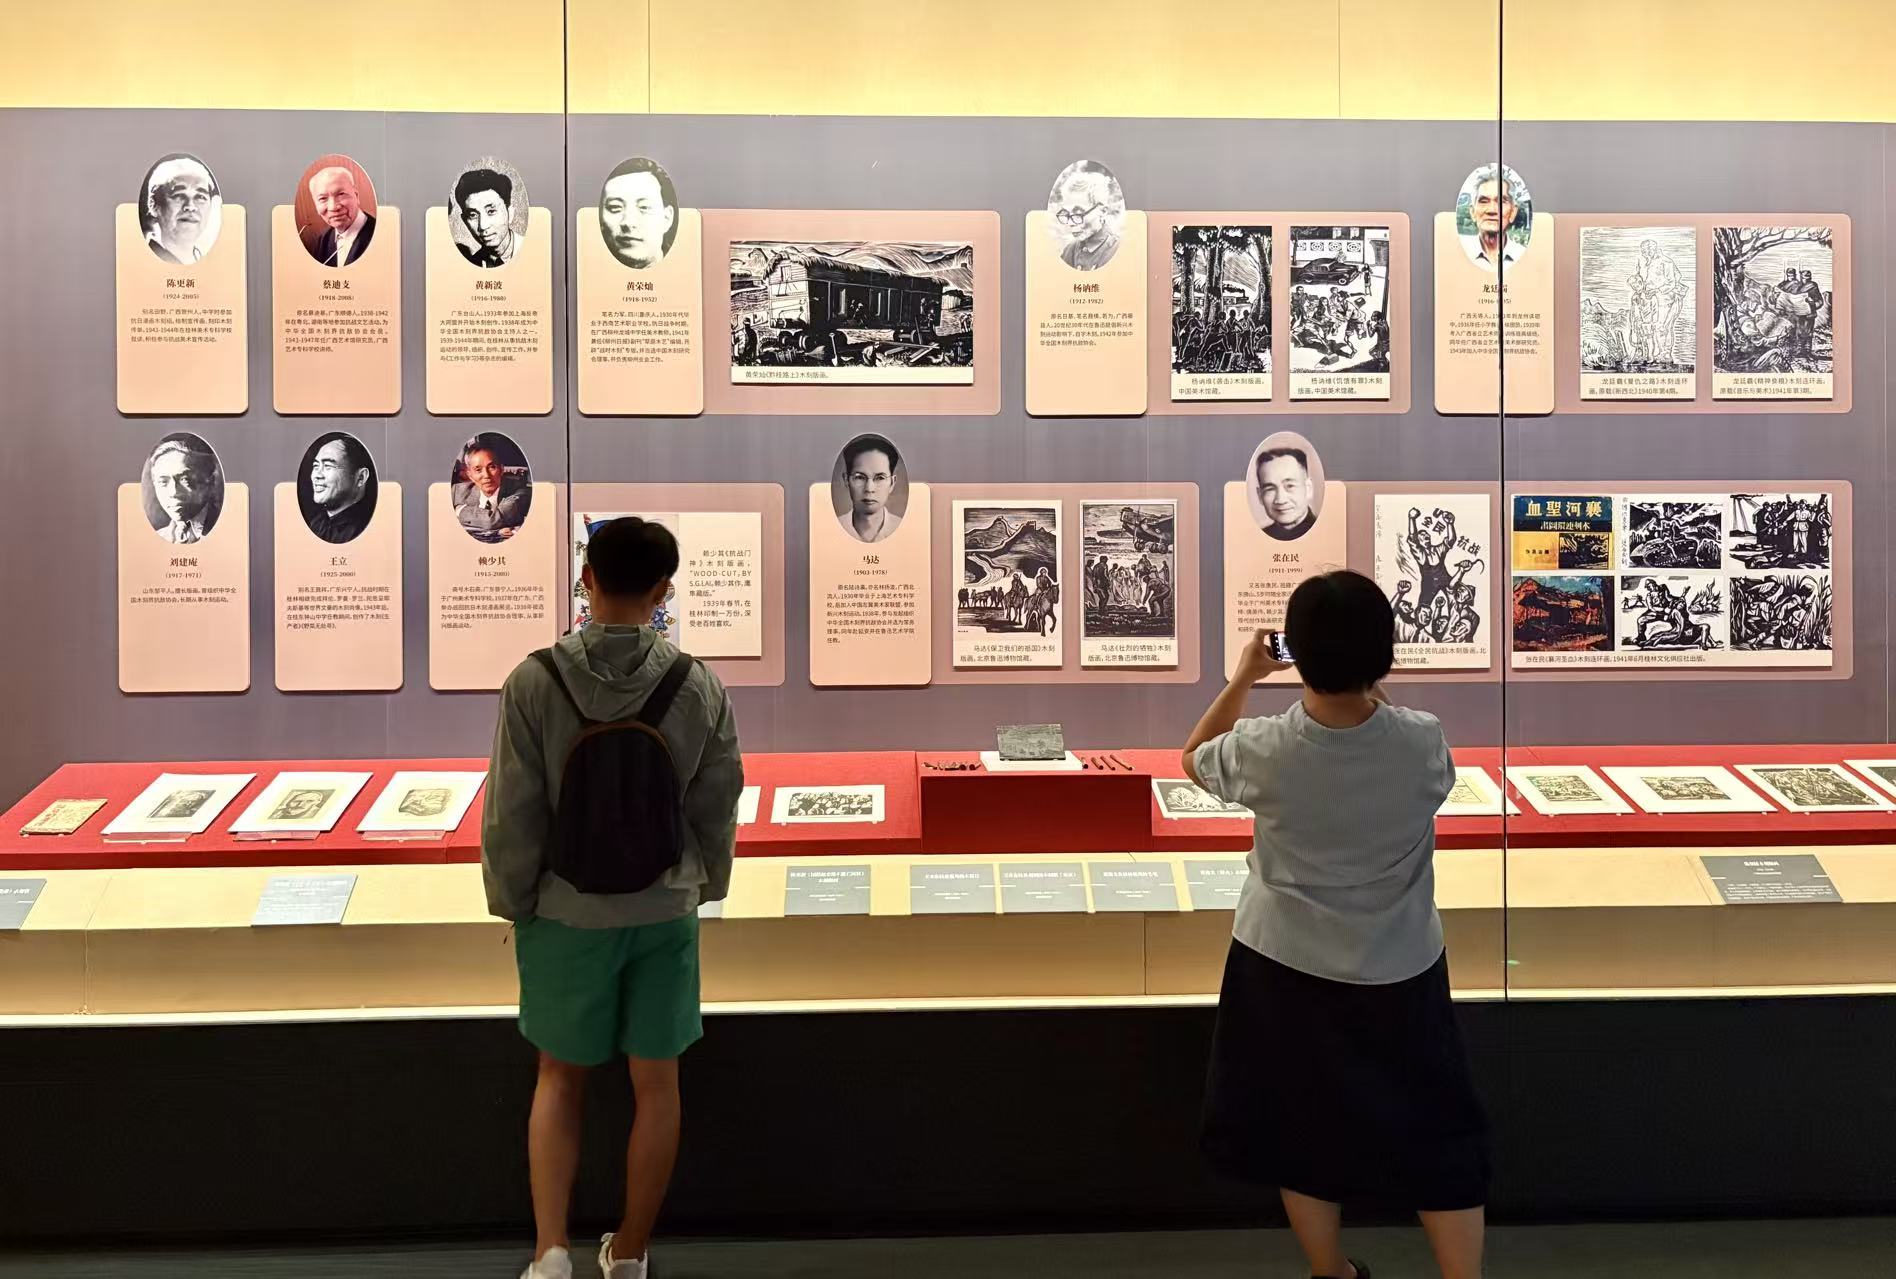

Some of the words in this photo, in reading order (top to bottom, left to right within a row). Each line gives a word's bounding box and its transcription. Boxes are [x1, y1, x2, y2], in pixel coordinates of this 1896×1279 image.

[166, 278, 195, 288] 陈更新
[323, 279, 351, 290] 蔡迪支
[475, 280, 503, 290] 黄新波
[626, 281, 654, 291] 黄荣灿
[1073, 283, 1100, 293] 杨讷维
[1456, 535, 1481, 557] 抗战
[703, 550, 752, 558] 赖少其《抗战门
[1272, 553, 1300, 563] 张在民
[170, 557, 198, 567] 刘建庵
[329, 556, 348, 566] 王立
[478, 556, 506, 566] 赖少其
[862, 555, 880, 565] 马达
